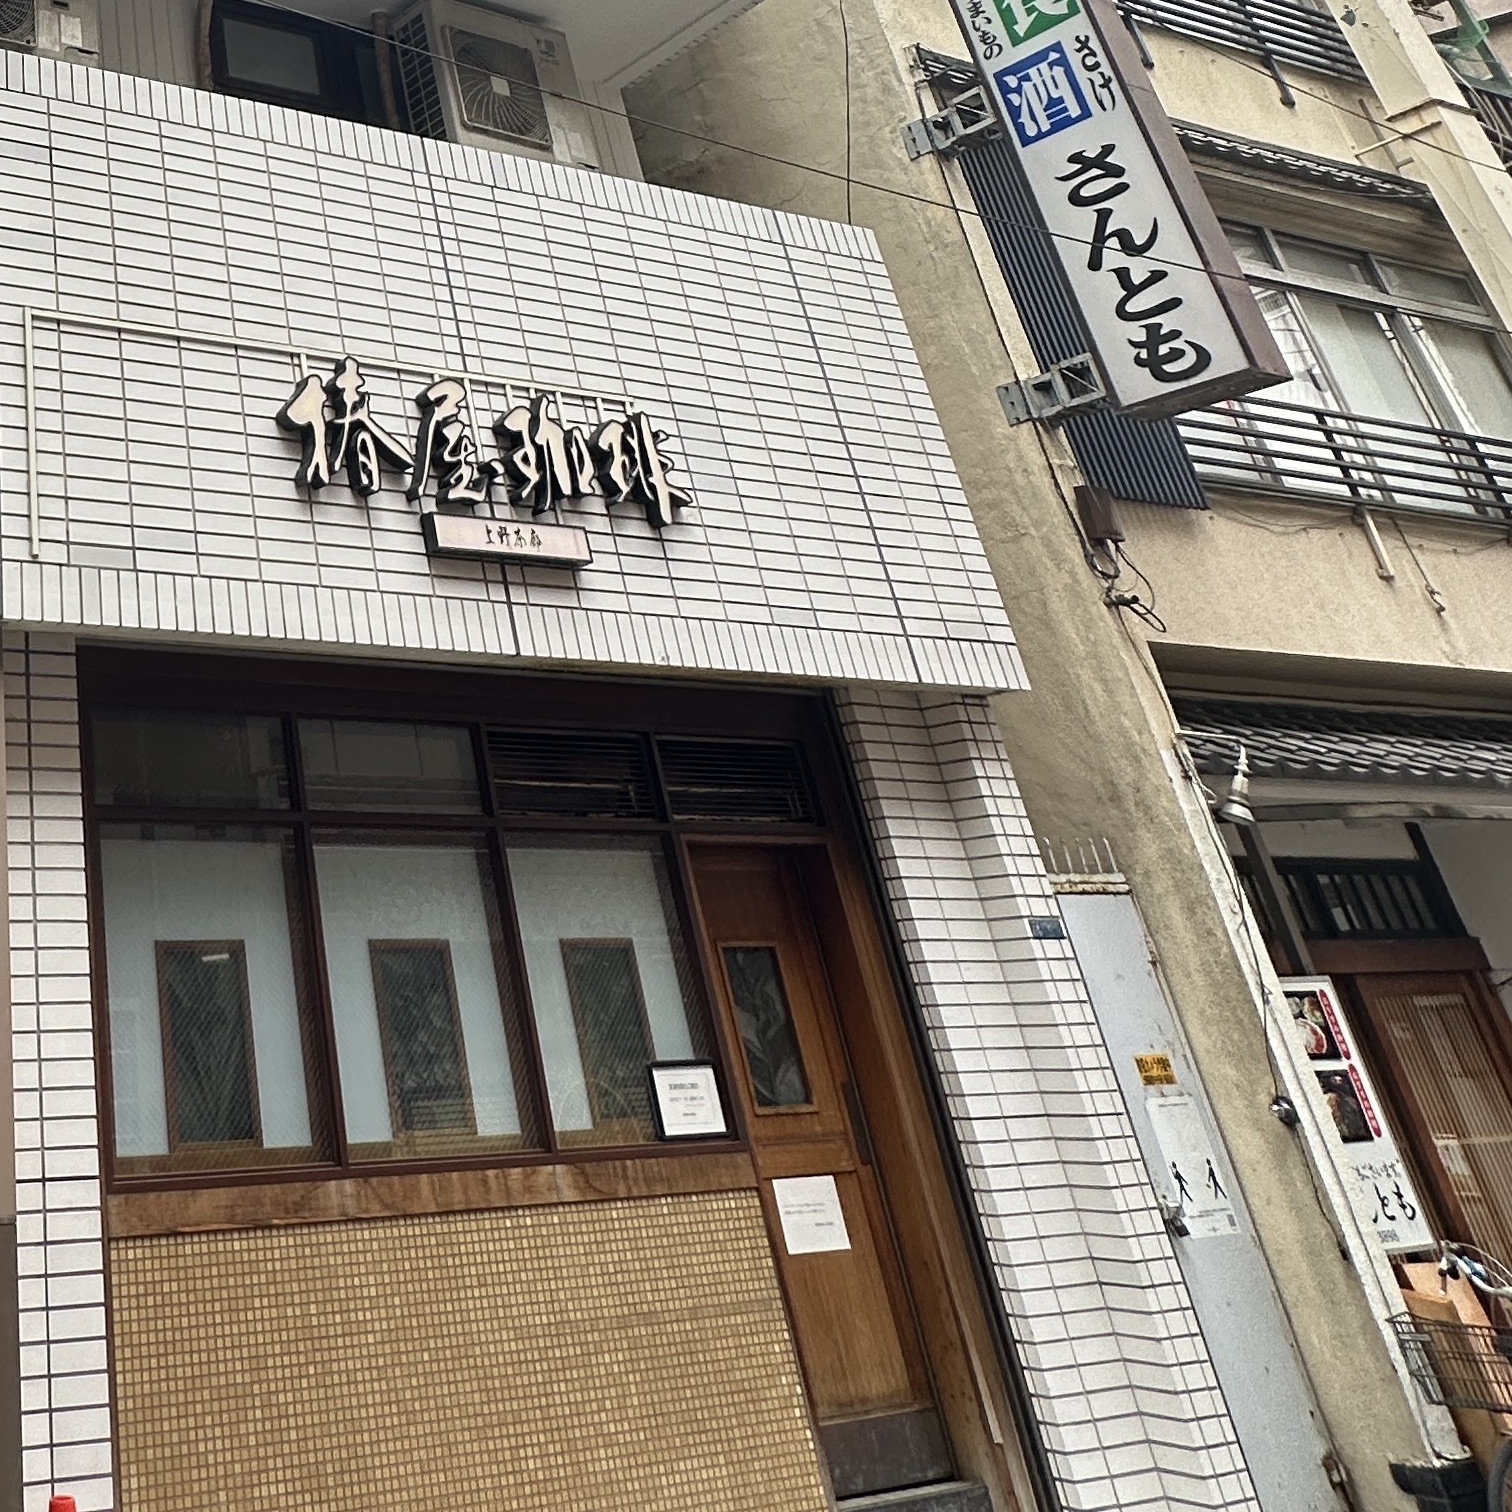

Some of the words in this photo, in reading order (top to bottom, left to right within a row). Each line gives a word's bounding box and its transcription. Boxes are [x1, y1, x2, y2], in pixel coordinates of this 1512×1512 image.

[1001, 50, 1083, 137] 酒
[1074, 35, 1116, 112] さけ
[1055, 143, 1212, 383] さんとも
